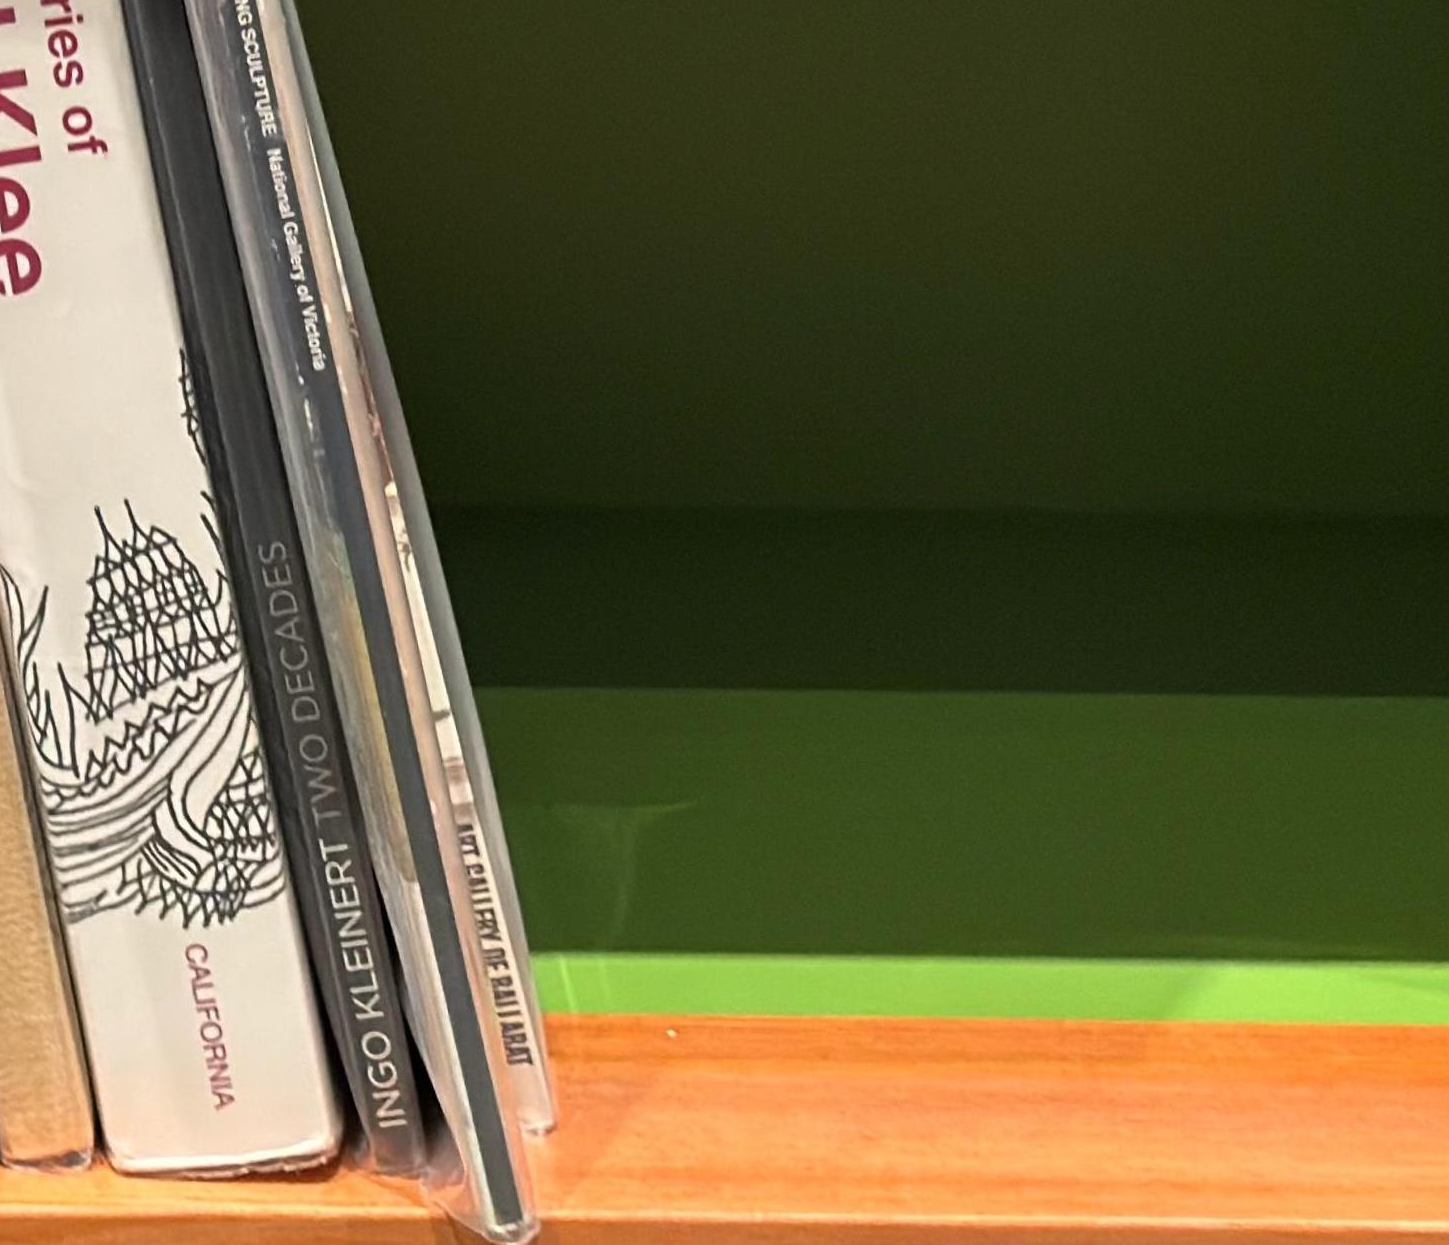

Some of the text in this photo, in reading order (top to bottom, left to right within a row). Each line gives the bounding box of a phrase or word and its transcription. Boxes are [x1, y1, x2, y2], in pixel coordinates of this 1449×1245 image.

[239, 26, 279, 138] SCULPTURE
[60, 104, 110, 156] of
[265, 146, 297, 220] National
[281, 220, 307, 283] Gallery
[295, 283, 315, 304] of
[300, 303, 328, 373] Victoria
[256, 539, 408, 1130] INGO KLEINERT TWO DECADES
[183, 942, 237, 1112] CALIFORNIA
